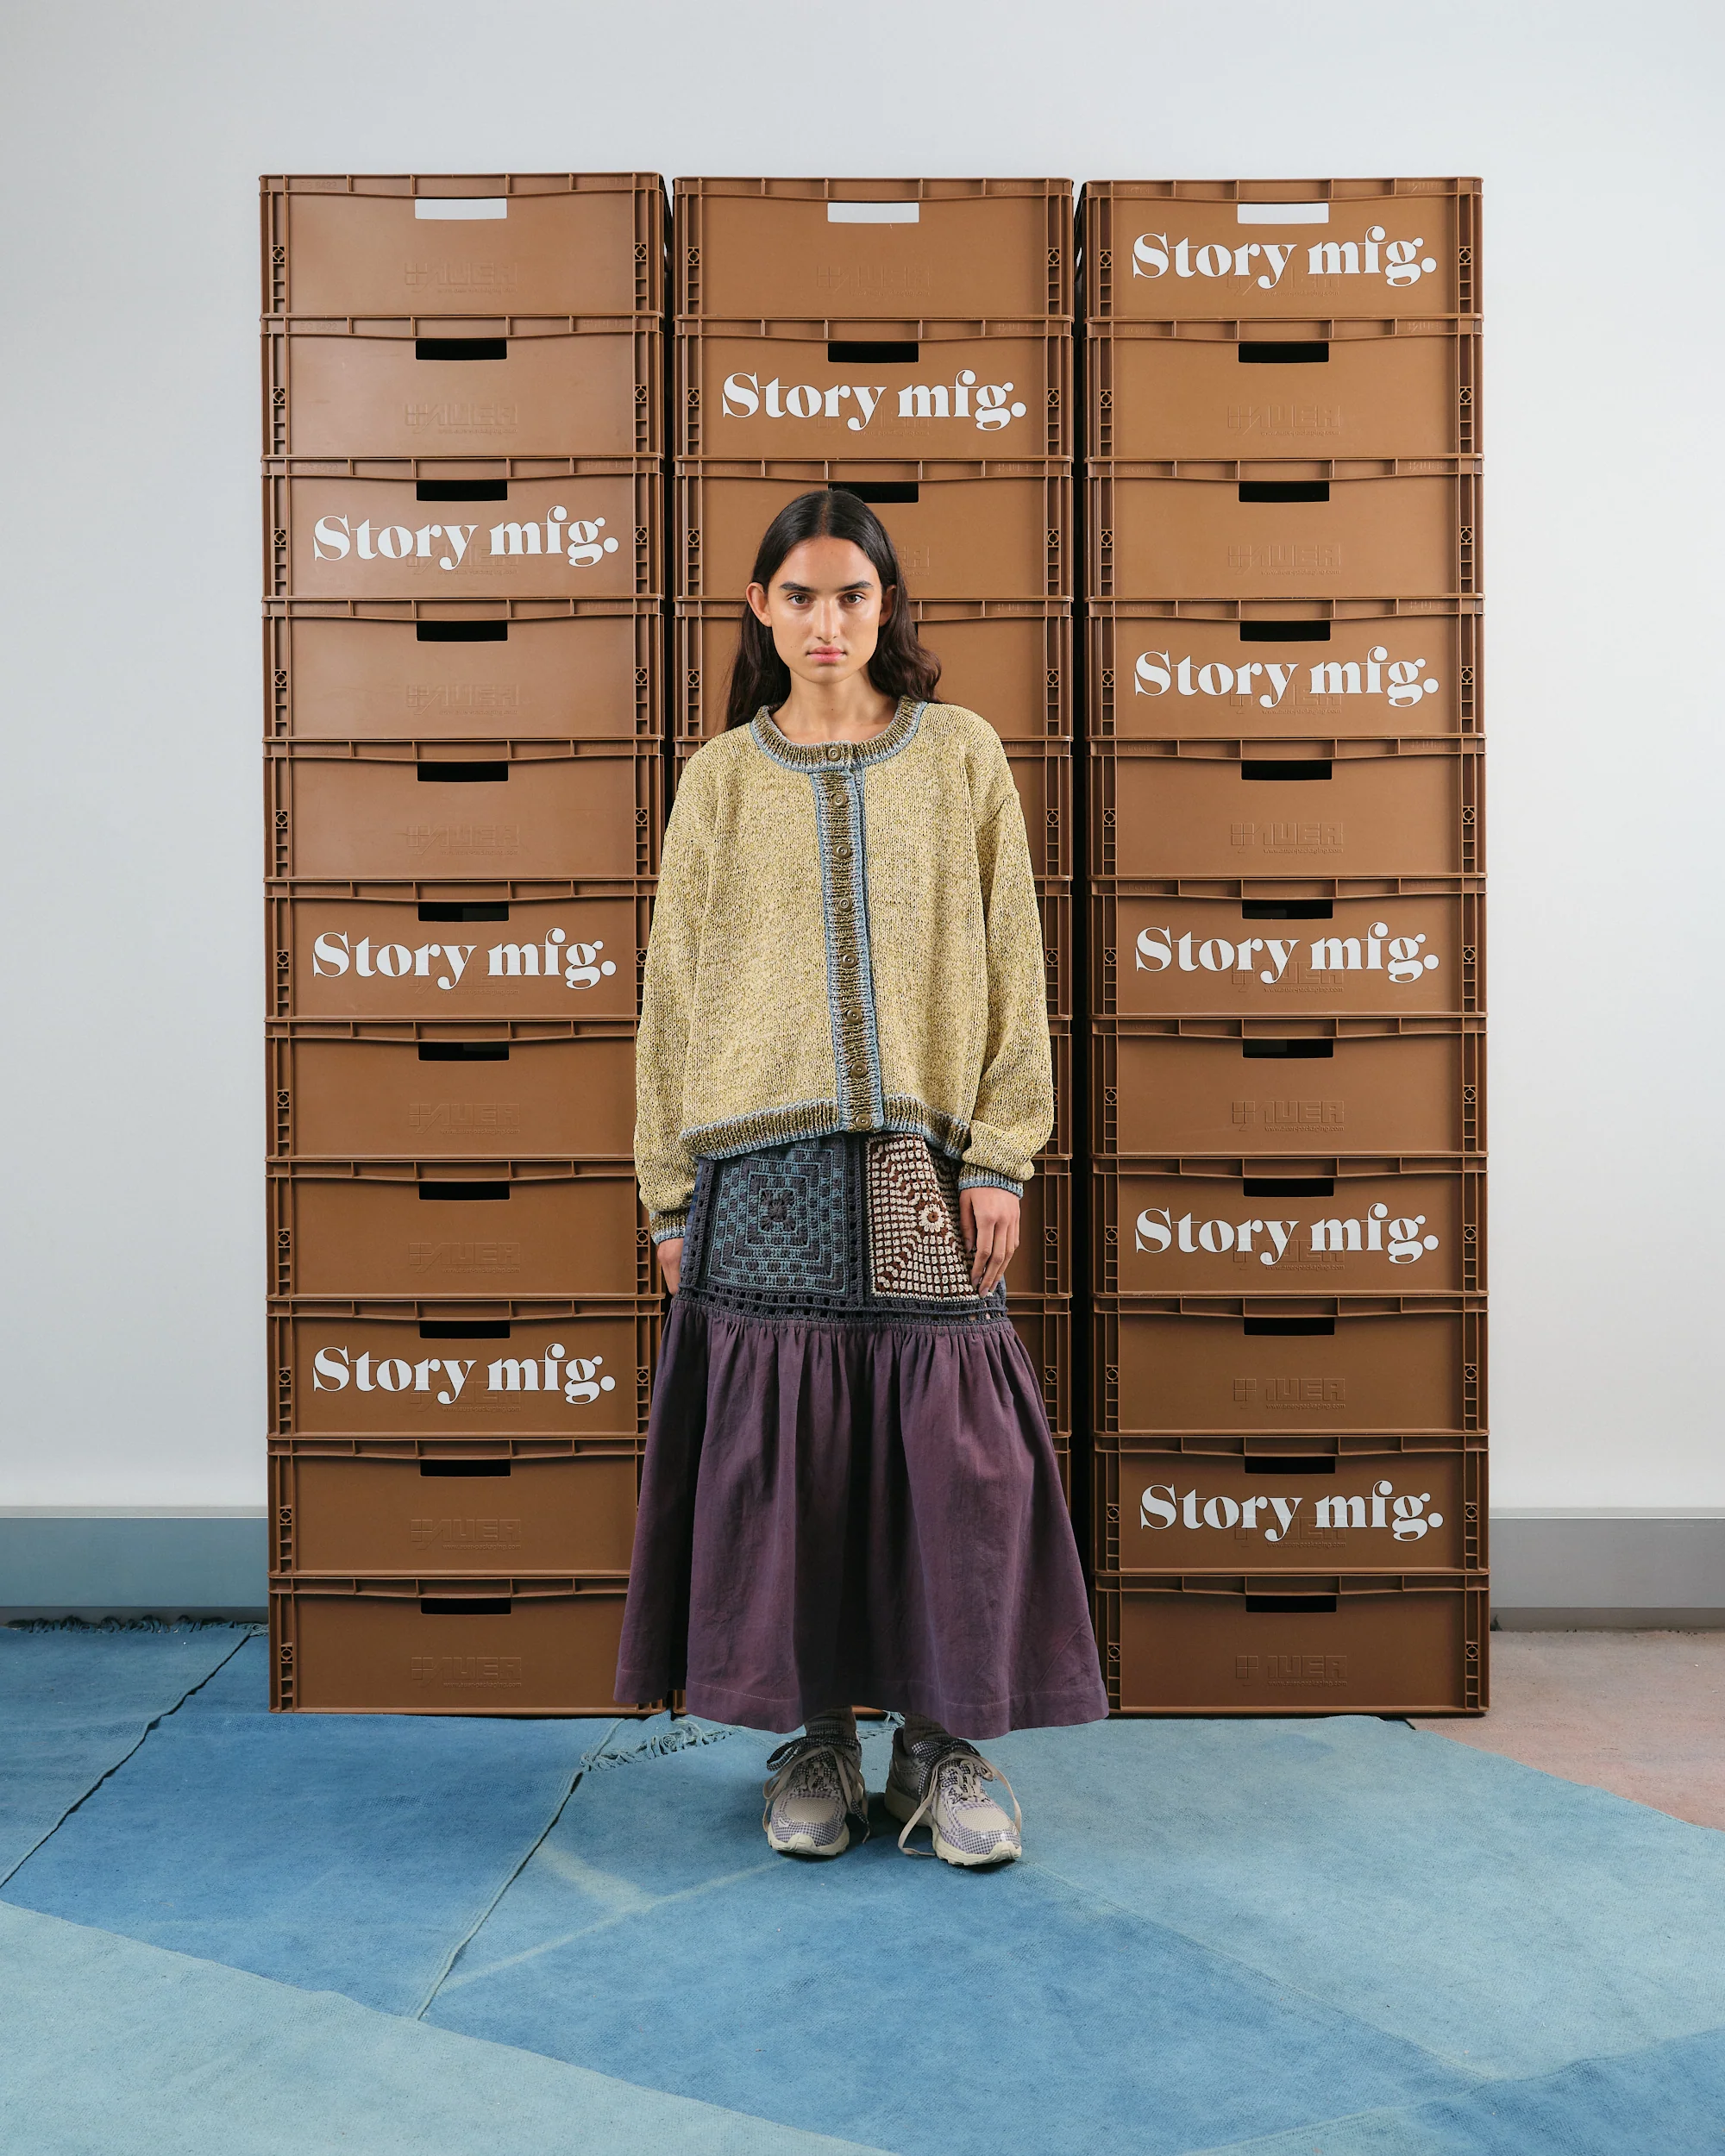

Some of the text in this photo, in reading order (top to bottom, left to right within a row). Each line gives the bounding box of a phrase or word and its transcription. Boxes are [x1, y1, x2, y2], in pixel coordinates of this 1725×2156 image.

[1131, 225, 1437, 290] Story mfg.
[721, 370, 888, 431] Story
[897, 369, 1027, 431] mfg.
[311, 505, 619, 571] Story mfg.
[1133, 645, 1440, 708] Story mfg.
[311, 927, 617, 990] Story mfg.
[1134, 921, 1440, 984] Story mfg.
[1134, 1202, 1440, 1266] Story mfg.
[311, 1343, 616, 1405] Story mfg.
[1138, 1480, 1444, 1542] Story mfg.
